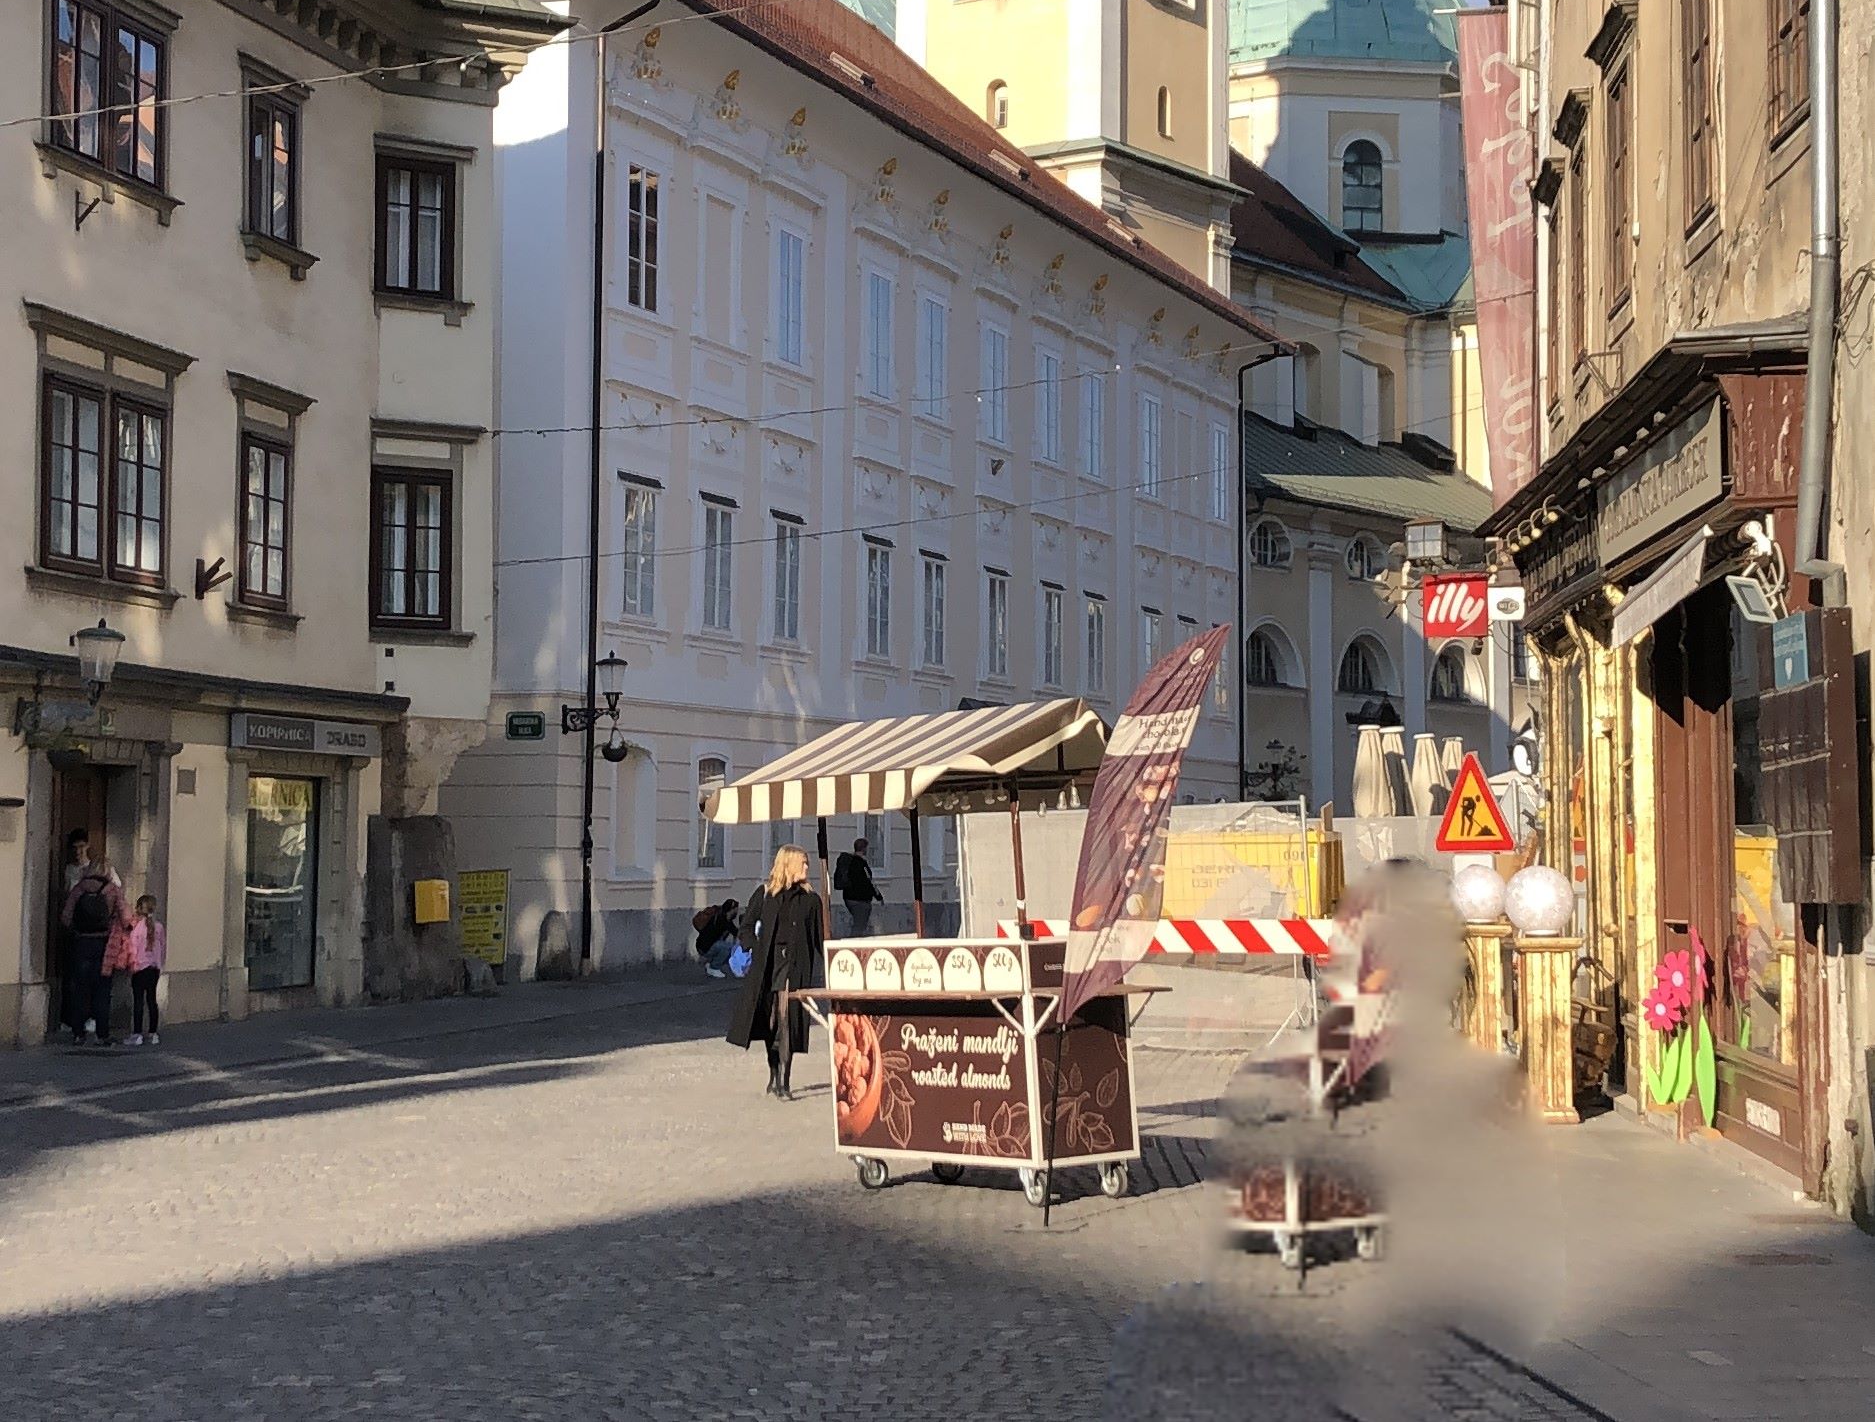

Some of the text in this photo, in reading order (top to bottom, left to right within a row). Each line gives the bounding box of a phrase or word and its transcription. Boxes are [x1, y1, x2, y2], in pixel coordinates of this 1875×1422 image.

[1427, 582, 1485, 632] illy
[901, 1023, 1019, 1064] Praženi mandlji
[911, 1061, 1011, 1090] roasted almonds
